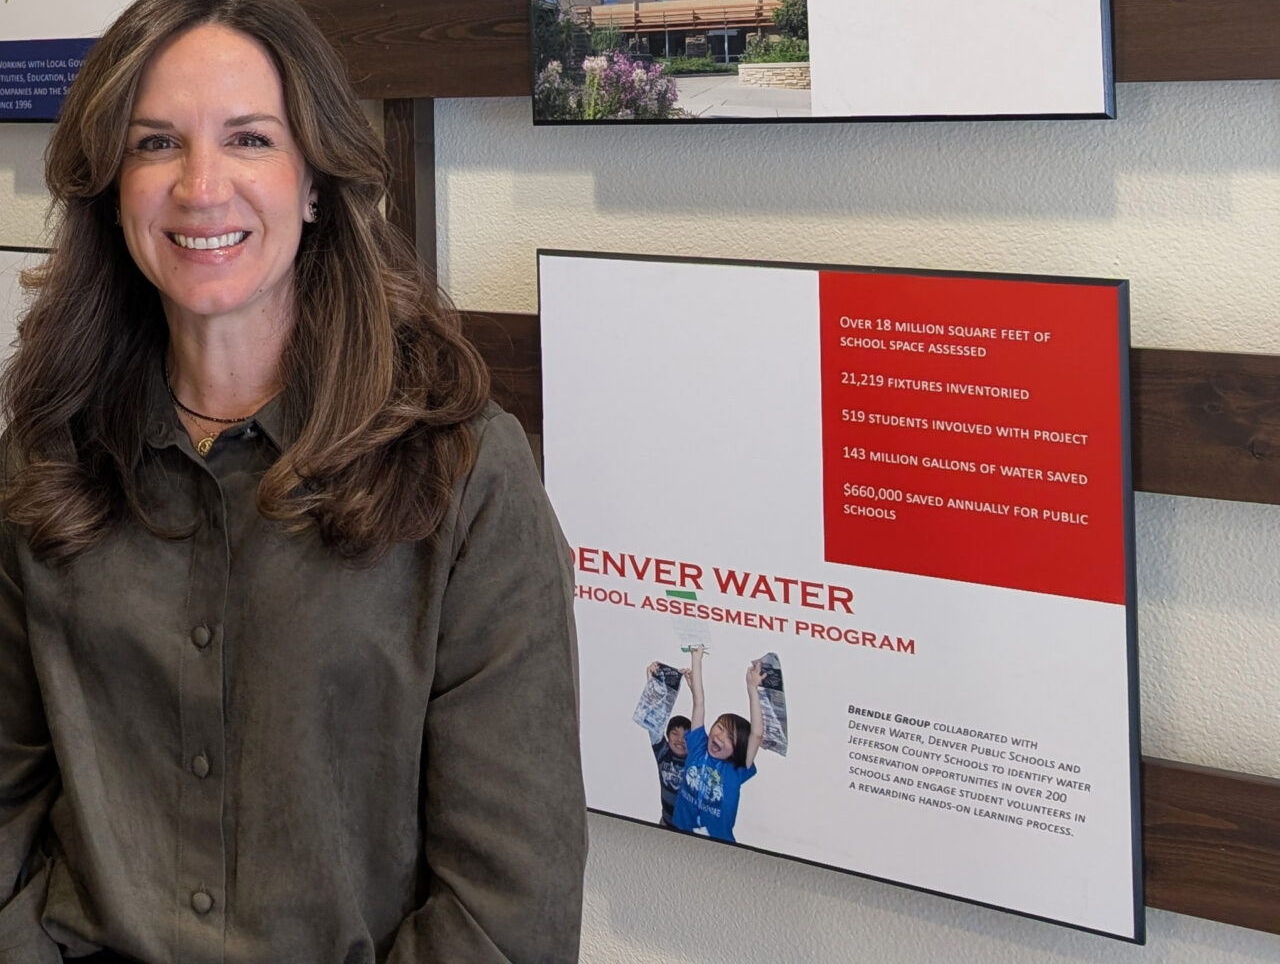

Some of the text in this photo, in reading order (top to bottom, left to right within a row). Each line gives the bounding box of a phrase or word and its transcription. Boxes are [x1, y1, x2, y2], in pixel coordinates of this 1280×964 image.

[26, 72, 66, 83] EDUCATION,
[27, 60, 45, 68] WITH
[46, 59, 67, 68] LOCAL
[15, 99, 32, 109] 1996
[33, 87, 48, 95] AND
[48, 87, 61, 95] THE
[839, 316, 1050, 342] OVER 18 MILLION SQUARE FEET OF
[840, 336, 986, 357] SCHOOL SPACE ASSESSED
[841, 371, 1029, 400] 21,219 FIXTURES INVENTORIED
[842, 409, 1088, 444] 519 STUDENTS INVOLVED WITH PROJECT
[843, 446, 1088, 485] 143 MILLION GALLONS OF WATER SAVED
[843, 482, 1088, 525] $660,000 SAVED ANNUALLY FOR PUBLIC
[843, 504, 896, 520] SCHOOLS
[712, 567, 854, 614] WATER
[640, 595, 788, 632] ASSESSMENT
[795, 620, 915, 654] PROGRAM
[847, 704, 1038, 749] BRENDLE GROUP COLLABORATED WITH
[847, 719, 1080, 774] DENVER WATER, DENVER PUBLIC SCHOOLS AND
[847, 735, 1091, 792] JEFFERSON COUNTY SCHOOLS TO IDENTIFY WATER
[848, 751, 1067, 803] CONSERVATION OPPORTUNITIES IN OVER 200
[848, 766, 1086, 823] SCHOOLS AND ENGAGE STUDENT VOLUNTEERS IN
[848, 781, 1073, 836] A REWARDING HANDS-ON LEARNING PROCESS.
